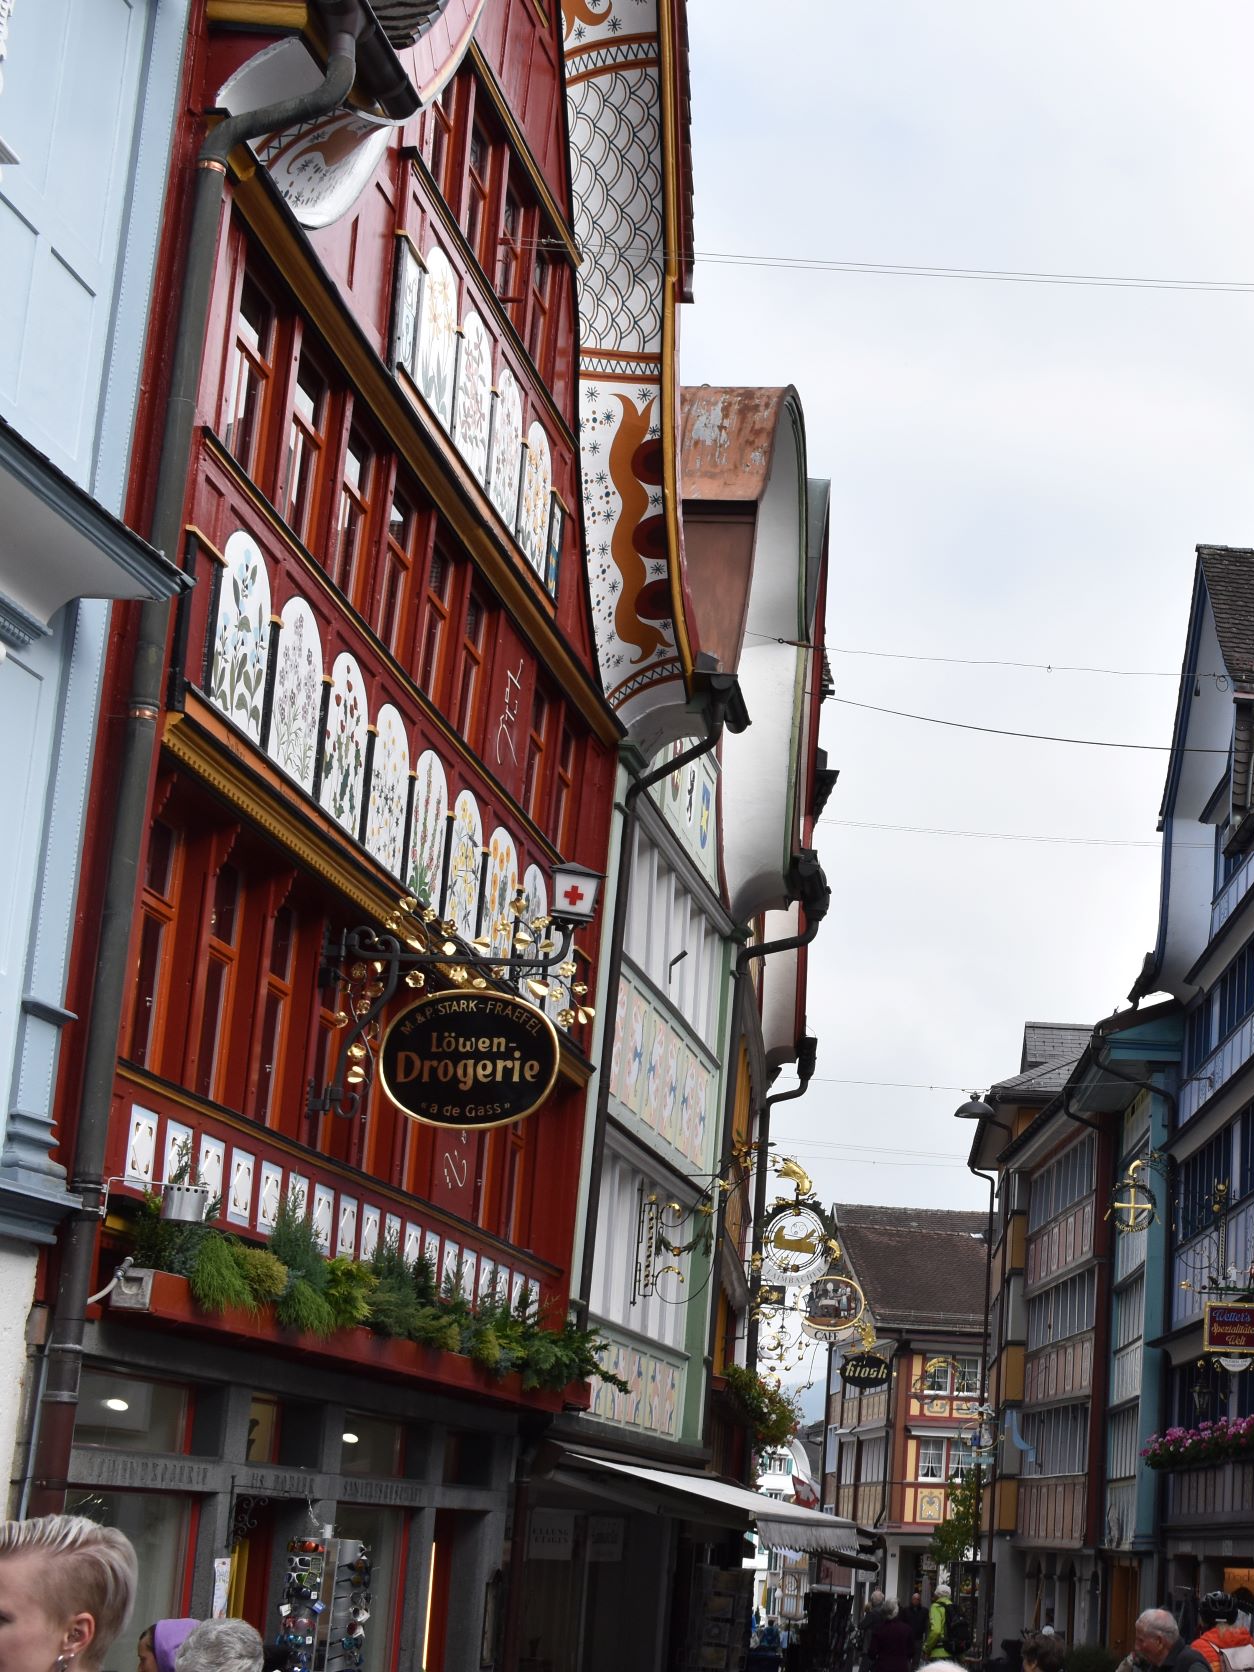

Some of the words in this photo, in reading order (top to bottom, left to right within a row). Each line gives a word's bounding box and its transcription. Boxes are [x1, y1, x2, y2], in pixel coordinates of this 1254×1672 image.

[431, 1032, 517, 1052] Löwen-
[395, 1050, 540, 1091] Drogerie
[443, 1104, 461, 1116] de
